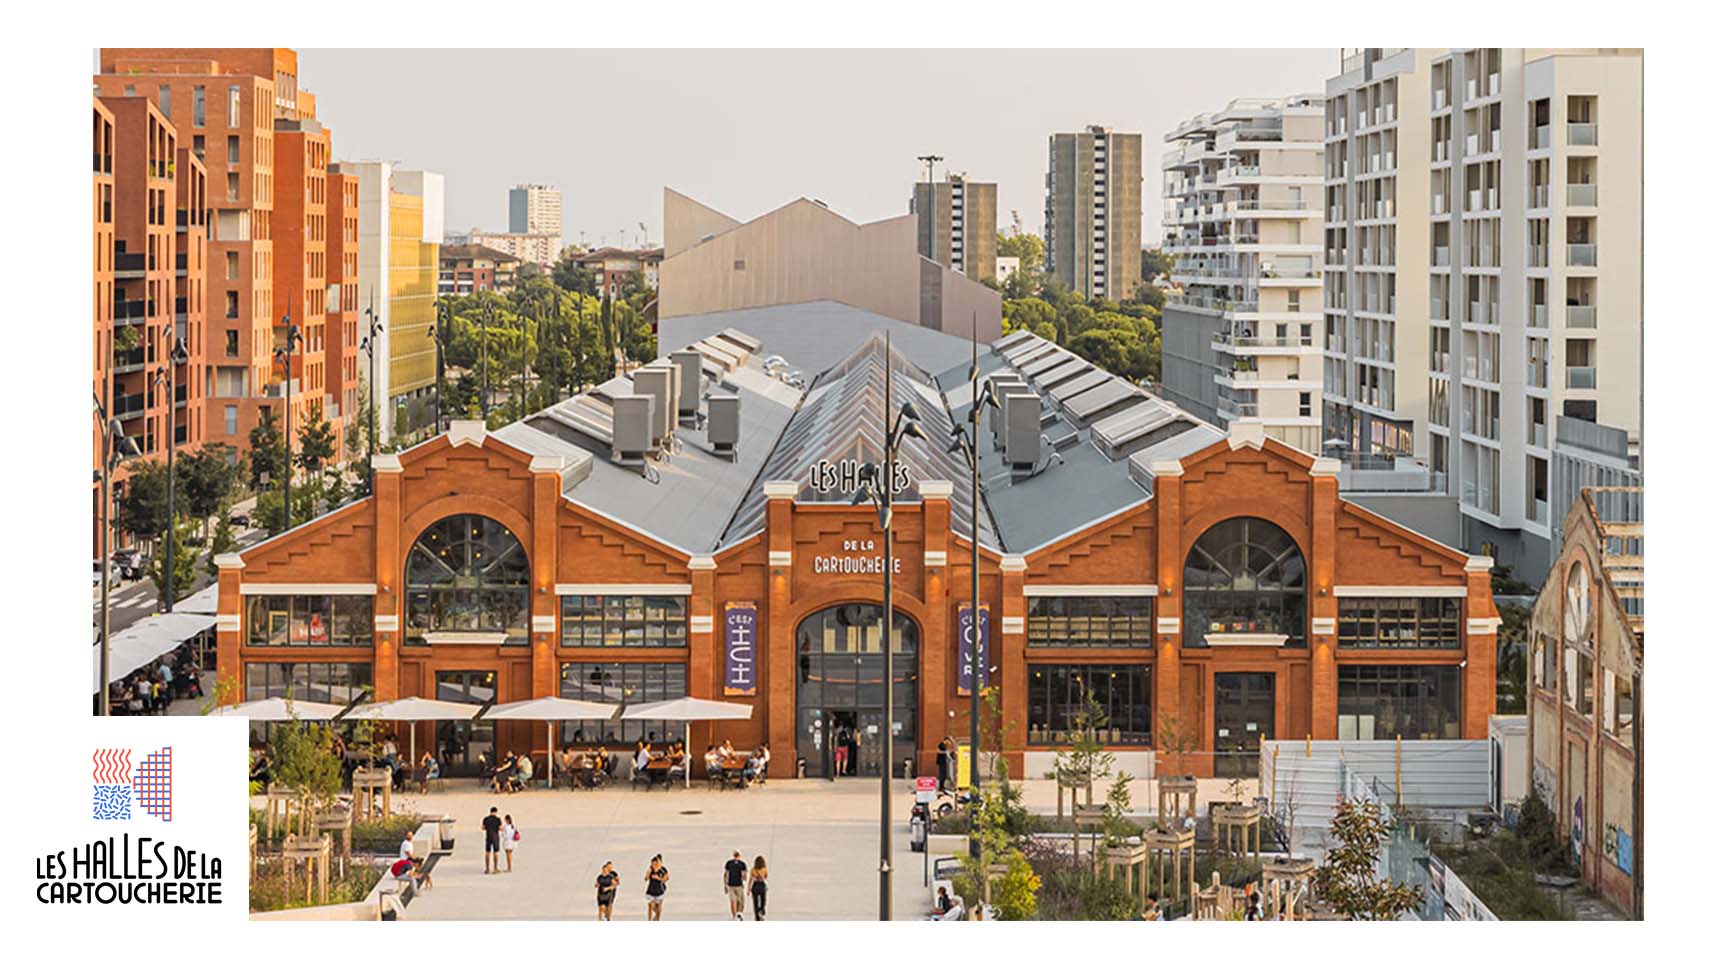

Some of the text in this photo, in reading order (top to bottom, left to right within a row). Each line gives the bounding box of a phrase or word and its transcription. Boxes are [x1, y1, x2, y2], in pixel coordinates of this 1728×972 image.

[811, 459, 910, 494] LES HAES
[843, 540, 874, 551] DE LA
